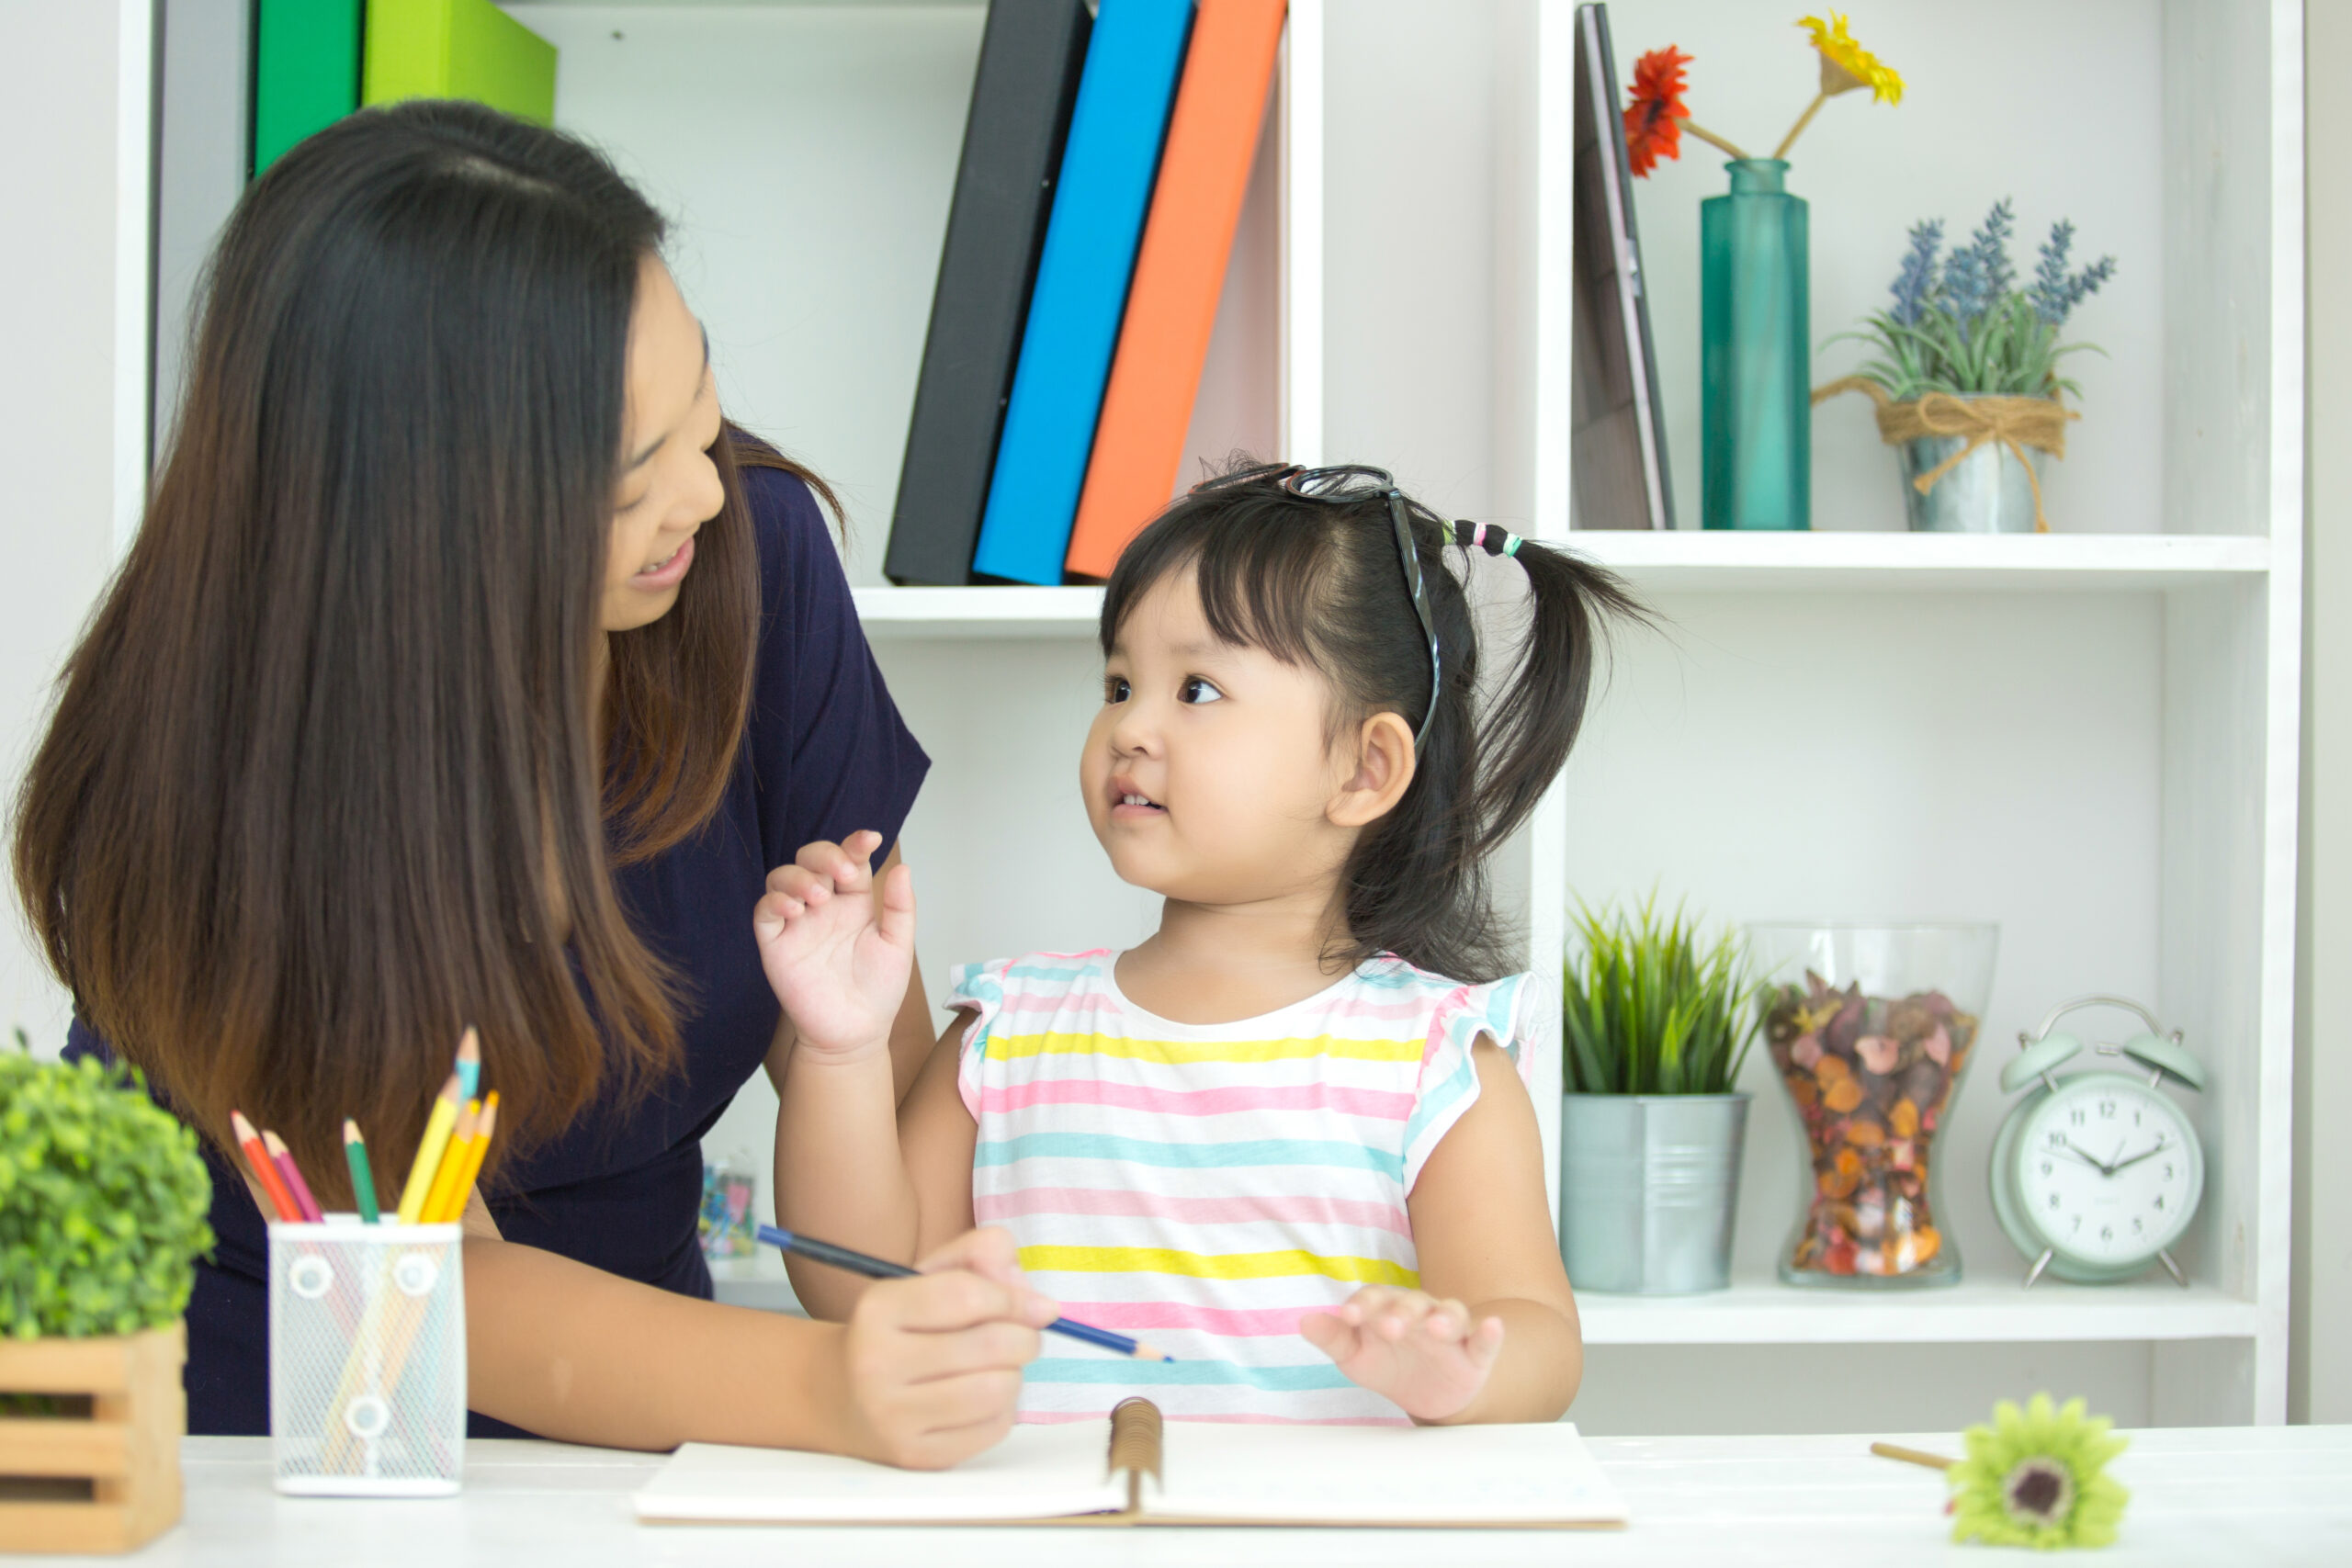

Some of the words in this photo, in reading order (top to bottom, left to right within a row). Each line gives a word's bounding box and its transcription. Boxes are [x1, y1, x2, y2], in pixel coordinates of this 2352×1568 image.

[2099, 1102, 2116, 1118] 12
[2071, 1111, 2085, 1125] 11
[2134, 1111, 2140, 1126] 1
[2049, 1133, 2066, 1147] 10
[2156, 1133, 2165, 1149] 2
[2041, 1163, 2052, 1177] 9
[2164, 1164, 2173, 1179] 3
[2050, 1194, 2059, 1209] 8
[2154, 1195, 2165, 1210] 4
[2073, 1215, 2082, 1232] 7
[2133, 1218, 2143, 1234] 5
[2100, 1225, 2112, 1240] 6
